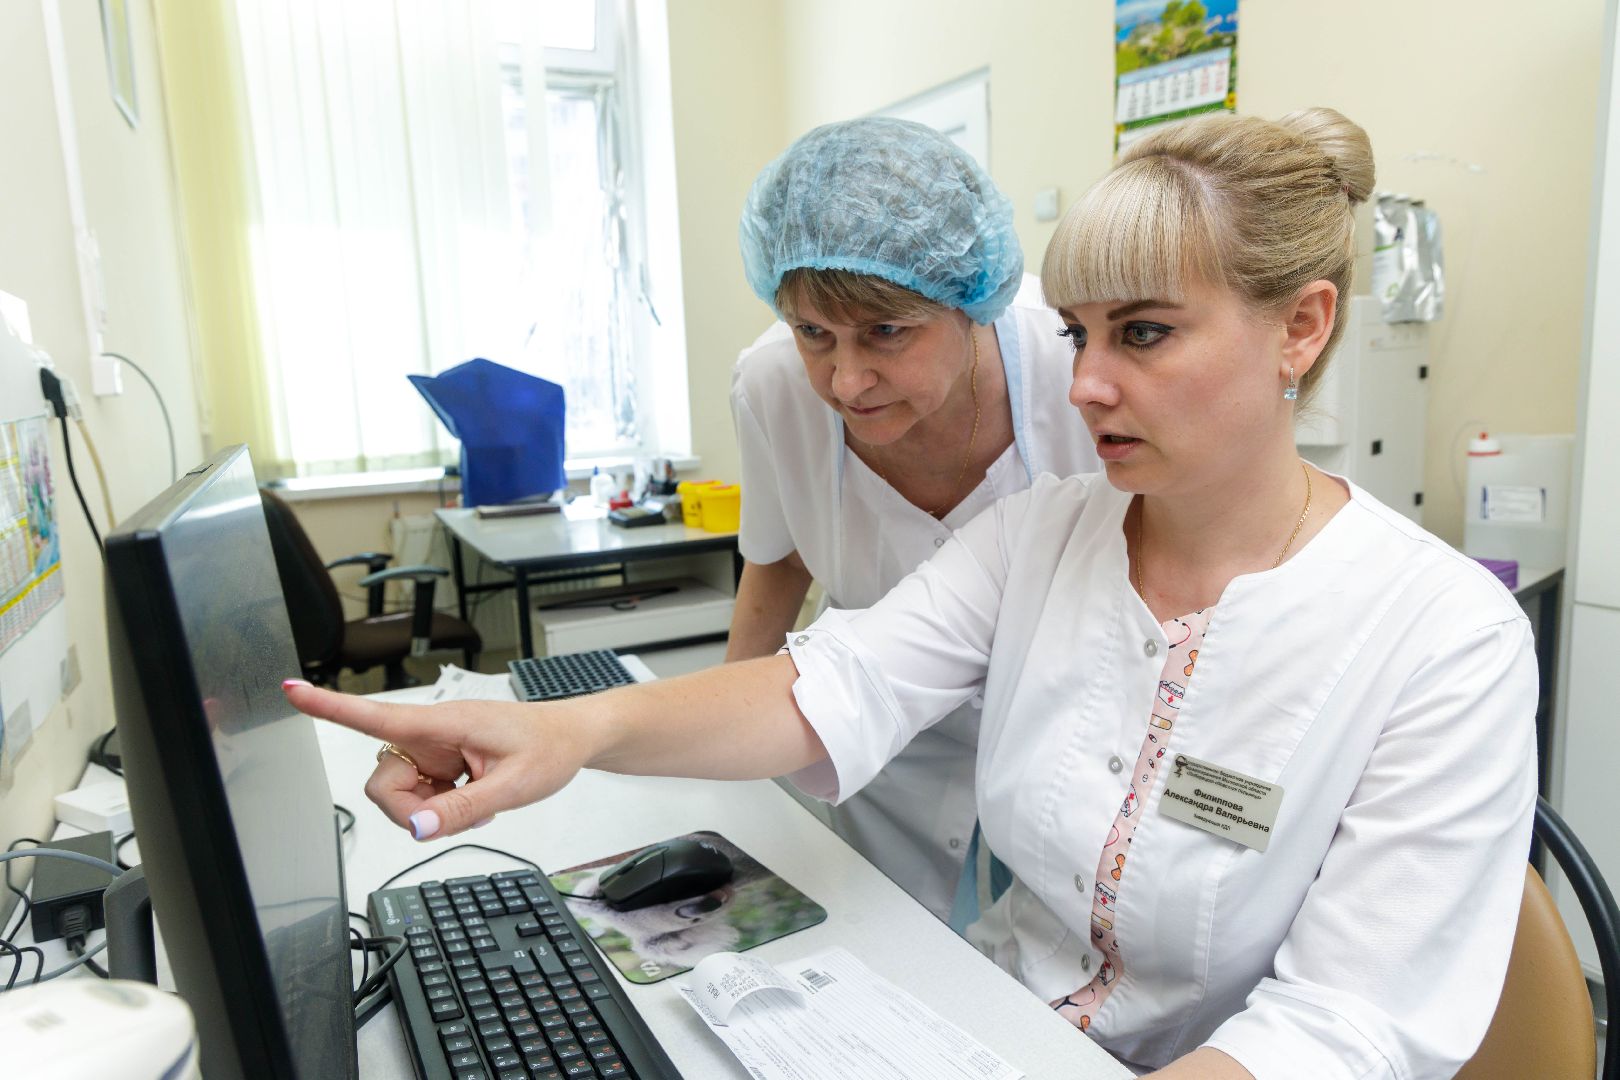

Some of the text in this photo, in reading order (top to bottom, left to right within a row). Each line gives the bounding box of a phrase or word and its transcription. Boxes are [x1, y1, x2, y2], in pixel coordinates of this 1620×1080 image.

[1163, 787, 1270, 833] Александра Валерьевна
[1194, 787, 1244, 812] Филиппова
